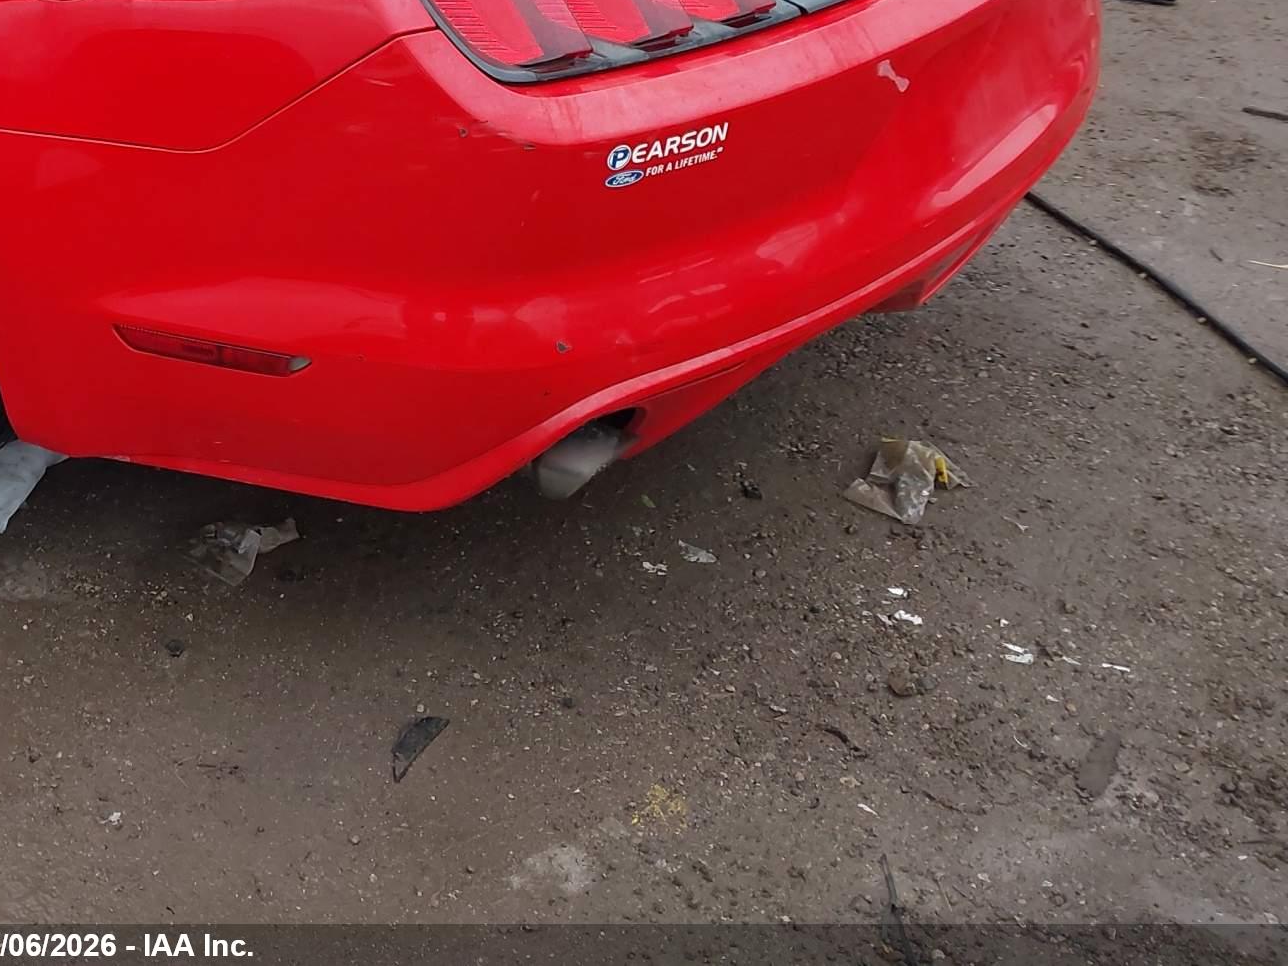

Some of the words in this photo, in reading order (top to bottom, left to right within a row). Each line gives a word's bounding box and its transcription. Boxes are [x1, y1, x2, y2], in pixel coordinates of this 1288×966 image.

[607, 122, 729, 170] PEARSON
[645, 164, 664, 177] FOR
[665, 161, 673, 172] A
[611, 172, 640, 186] Ford
